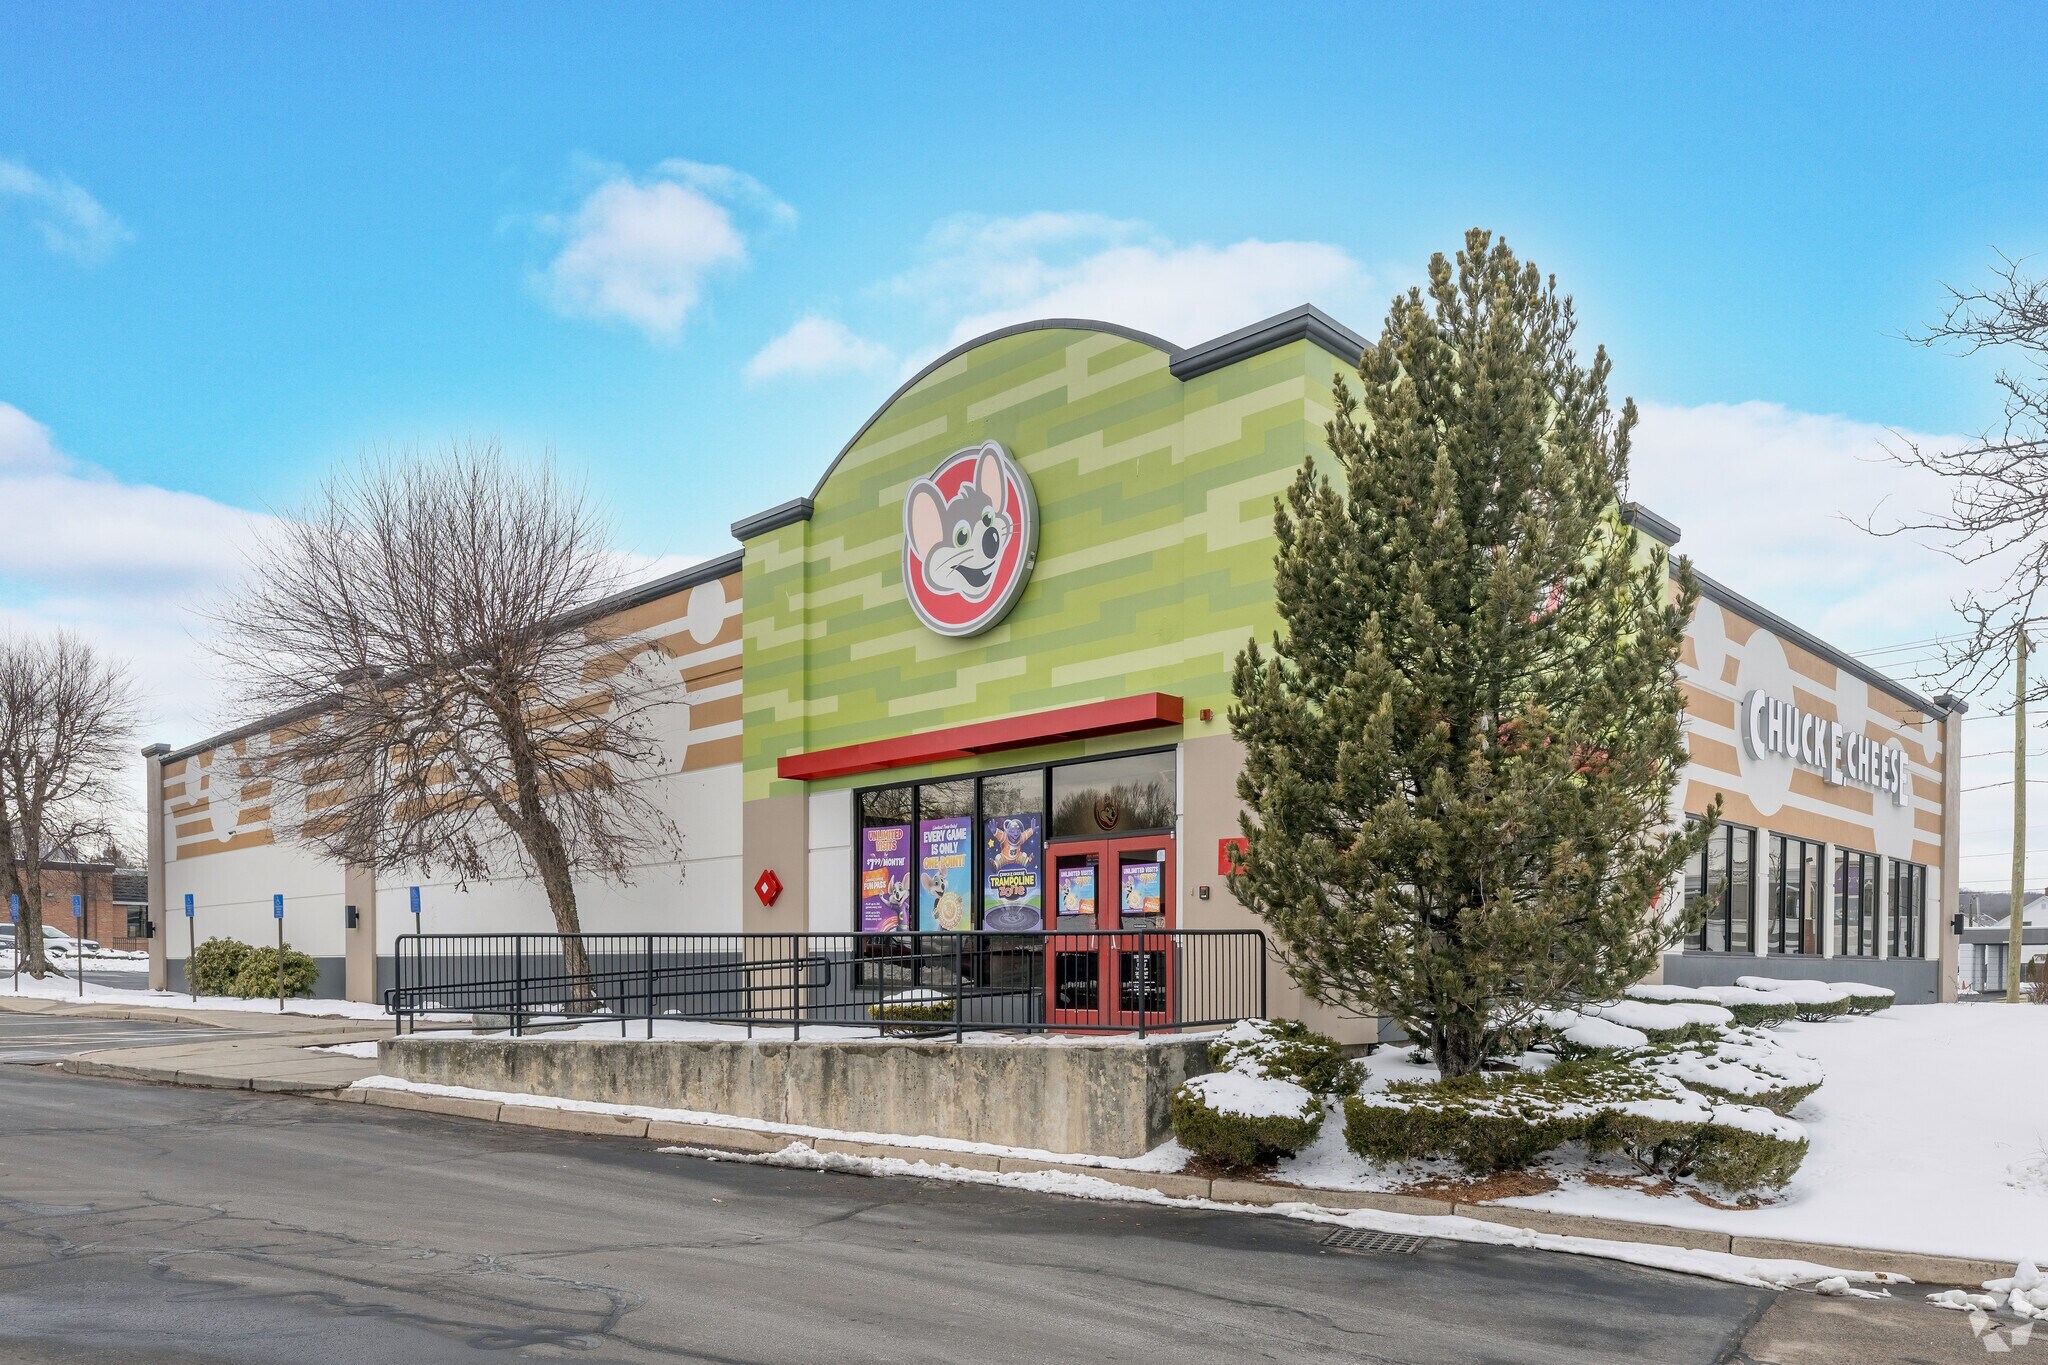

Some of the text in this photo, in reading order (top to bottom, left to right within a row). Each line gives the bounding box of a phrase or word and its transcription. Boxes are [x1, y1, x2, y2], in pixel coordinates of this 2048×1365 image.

[1742, 688, 1909, 807] CHUCK E. CHEESE
[868, 829, 903, 841] UNLIMITED
[924, 827, 967, 843] EVERY GAME
[876, 840, 897, 852] VISITS
[931, 841, 958, 856] IS ONLY
[923, 853, 967, 869] ONE POINT!
[863, 880, 887, 890] FUN PASS
[991, 875, 1034, 887] TRAMPOLINE
